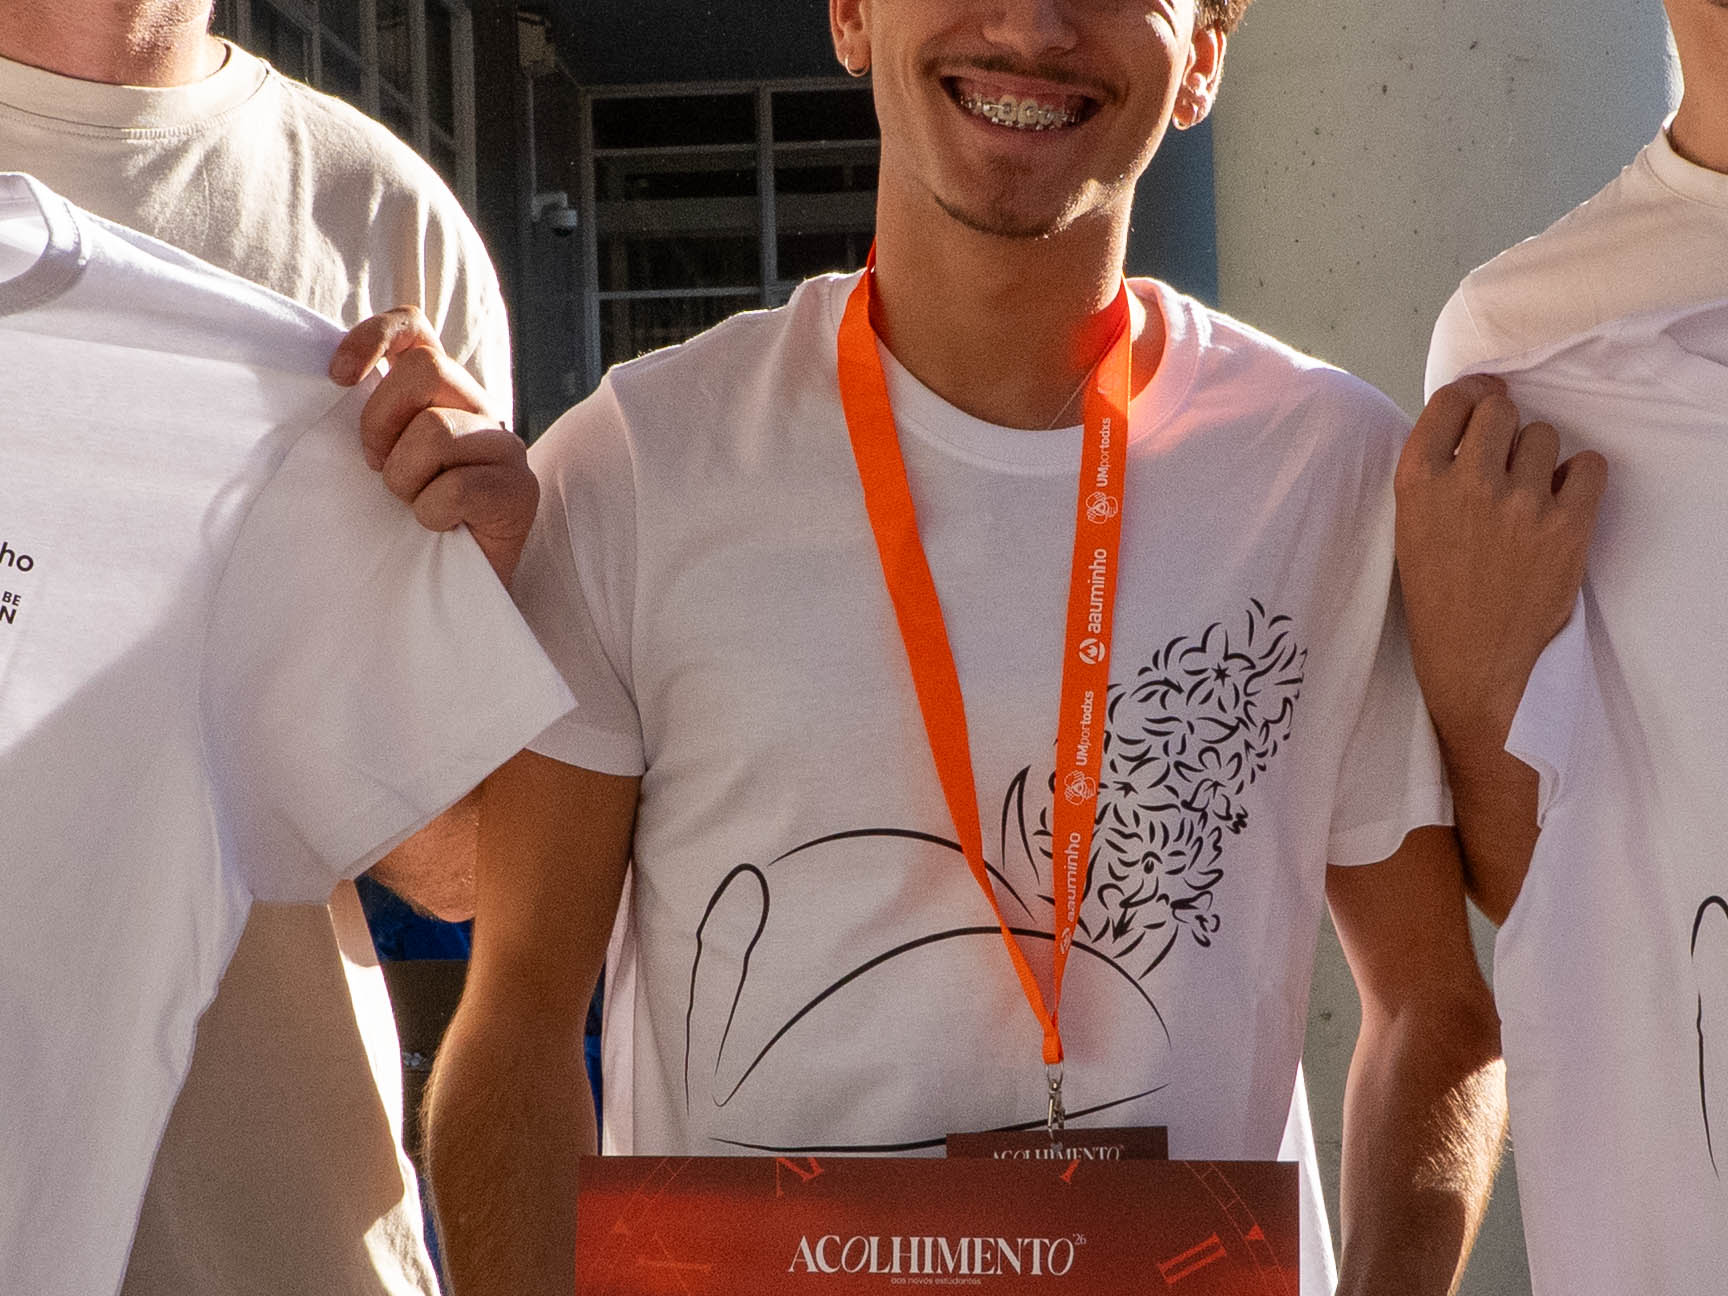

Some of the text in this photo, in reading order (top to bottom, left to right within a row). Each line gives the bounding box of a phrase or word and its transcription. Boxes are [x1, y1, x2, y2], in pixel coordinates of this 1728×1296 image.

[2, 591, 21, 607] BE
[1088, 547, 1108, 635] aauminho
[1064, 831, 1082, 923] aauminho
[787, 1234, 1074, 1277] ACOLHIMENTO
